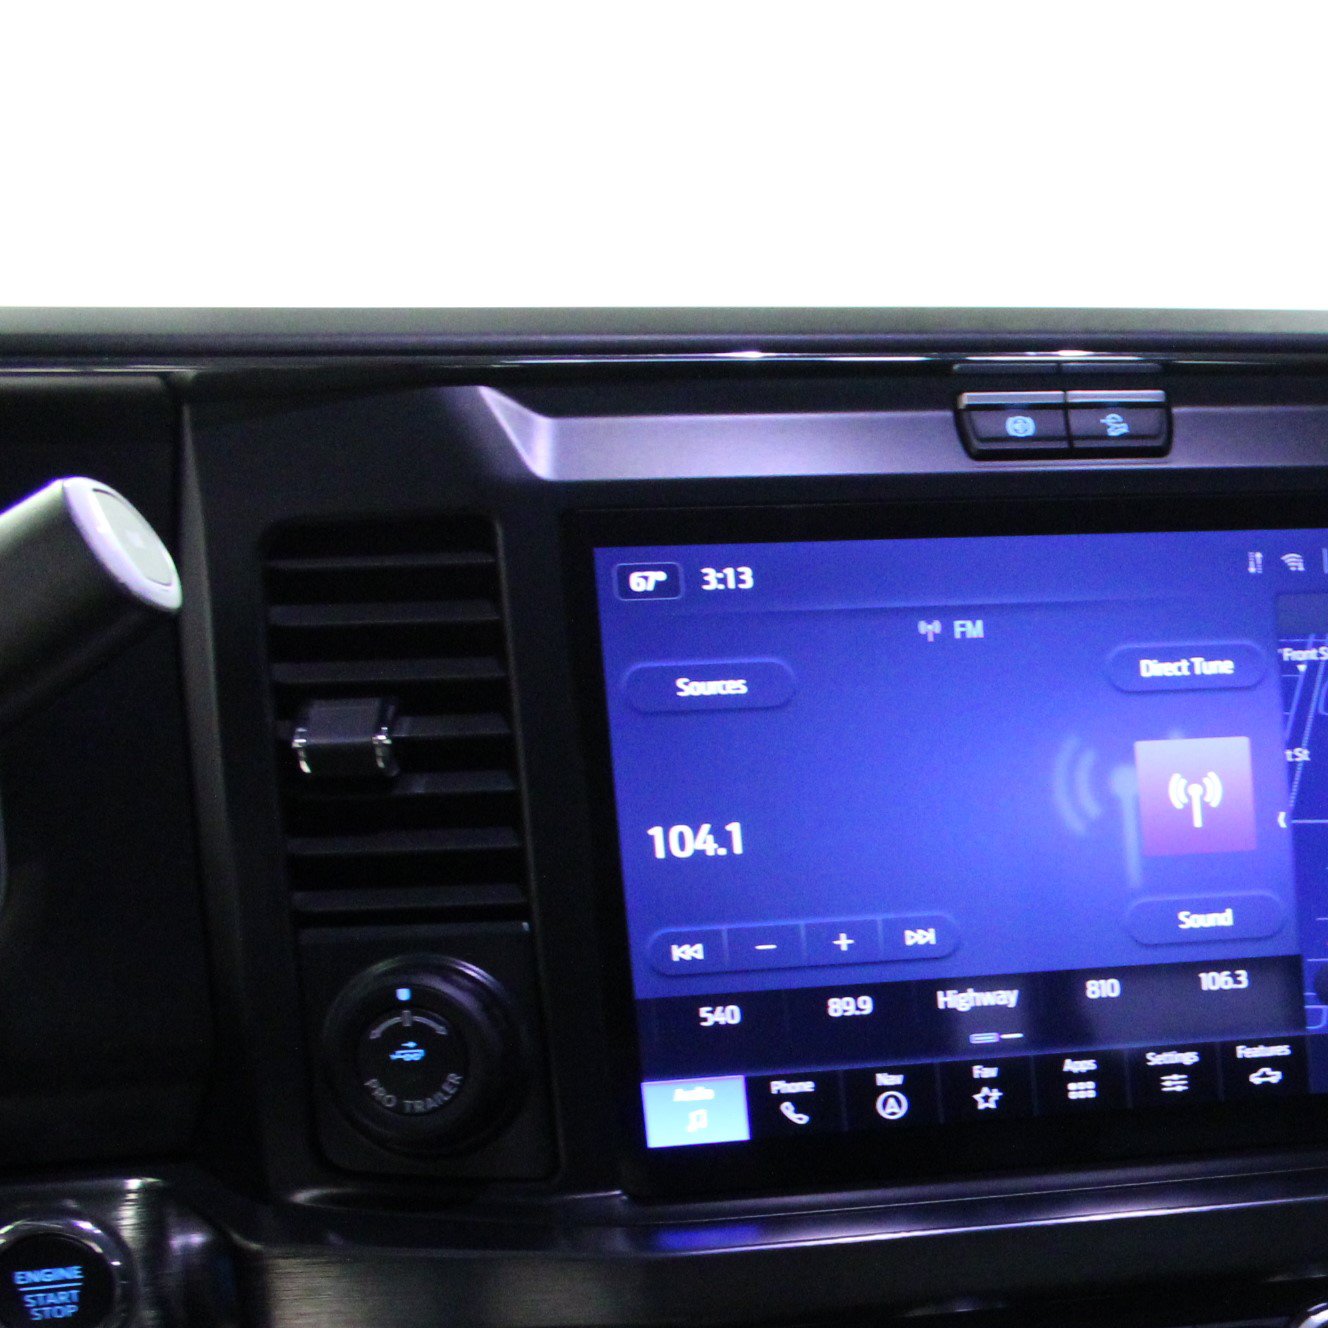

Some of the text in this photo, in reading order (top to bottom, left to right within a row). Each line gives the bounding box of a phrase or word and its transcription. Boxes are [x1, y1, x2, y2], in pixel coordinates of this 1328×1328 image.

[700, 566, 754, 590] 3:13
[953, 620, 985, 639] FM
[1139, 656, 1235, 678] Direct Tune
[675, 677, 748, 697] Sources
[646, 822, 744, 859] 104.1
[1177, 908, 1234, 930] Sound
[1086, 979, 1121, 999] 810
[1198, 970, 1248, 991] 106.3
[827, 996, 873, 1017] 89.9
[936, 987, 1020, 1011] Highway
[699, 1005, 742, 1026] 540
[875, 1072, 904, 1087] Nav
[12, 1266, 85, 1285] ENGINE
[23, 1290, 81, 1307] START
[31, 1305, 79, 1321] STOP
